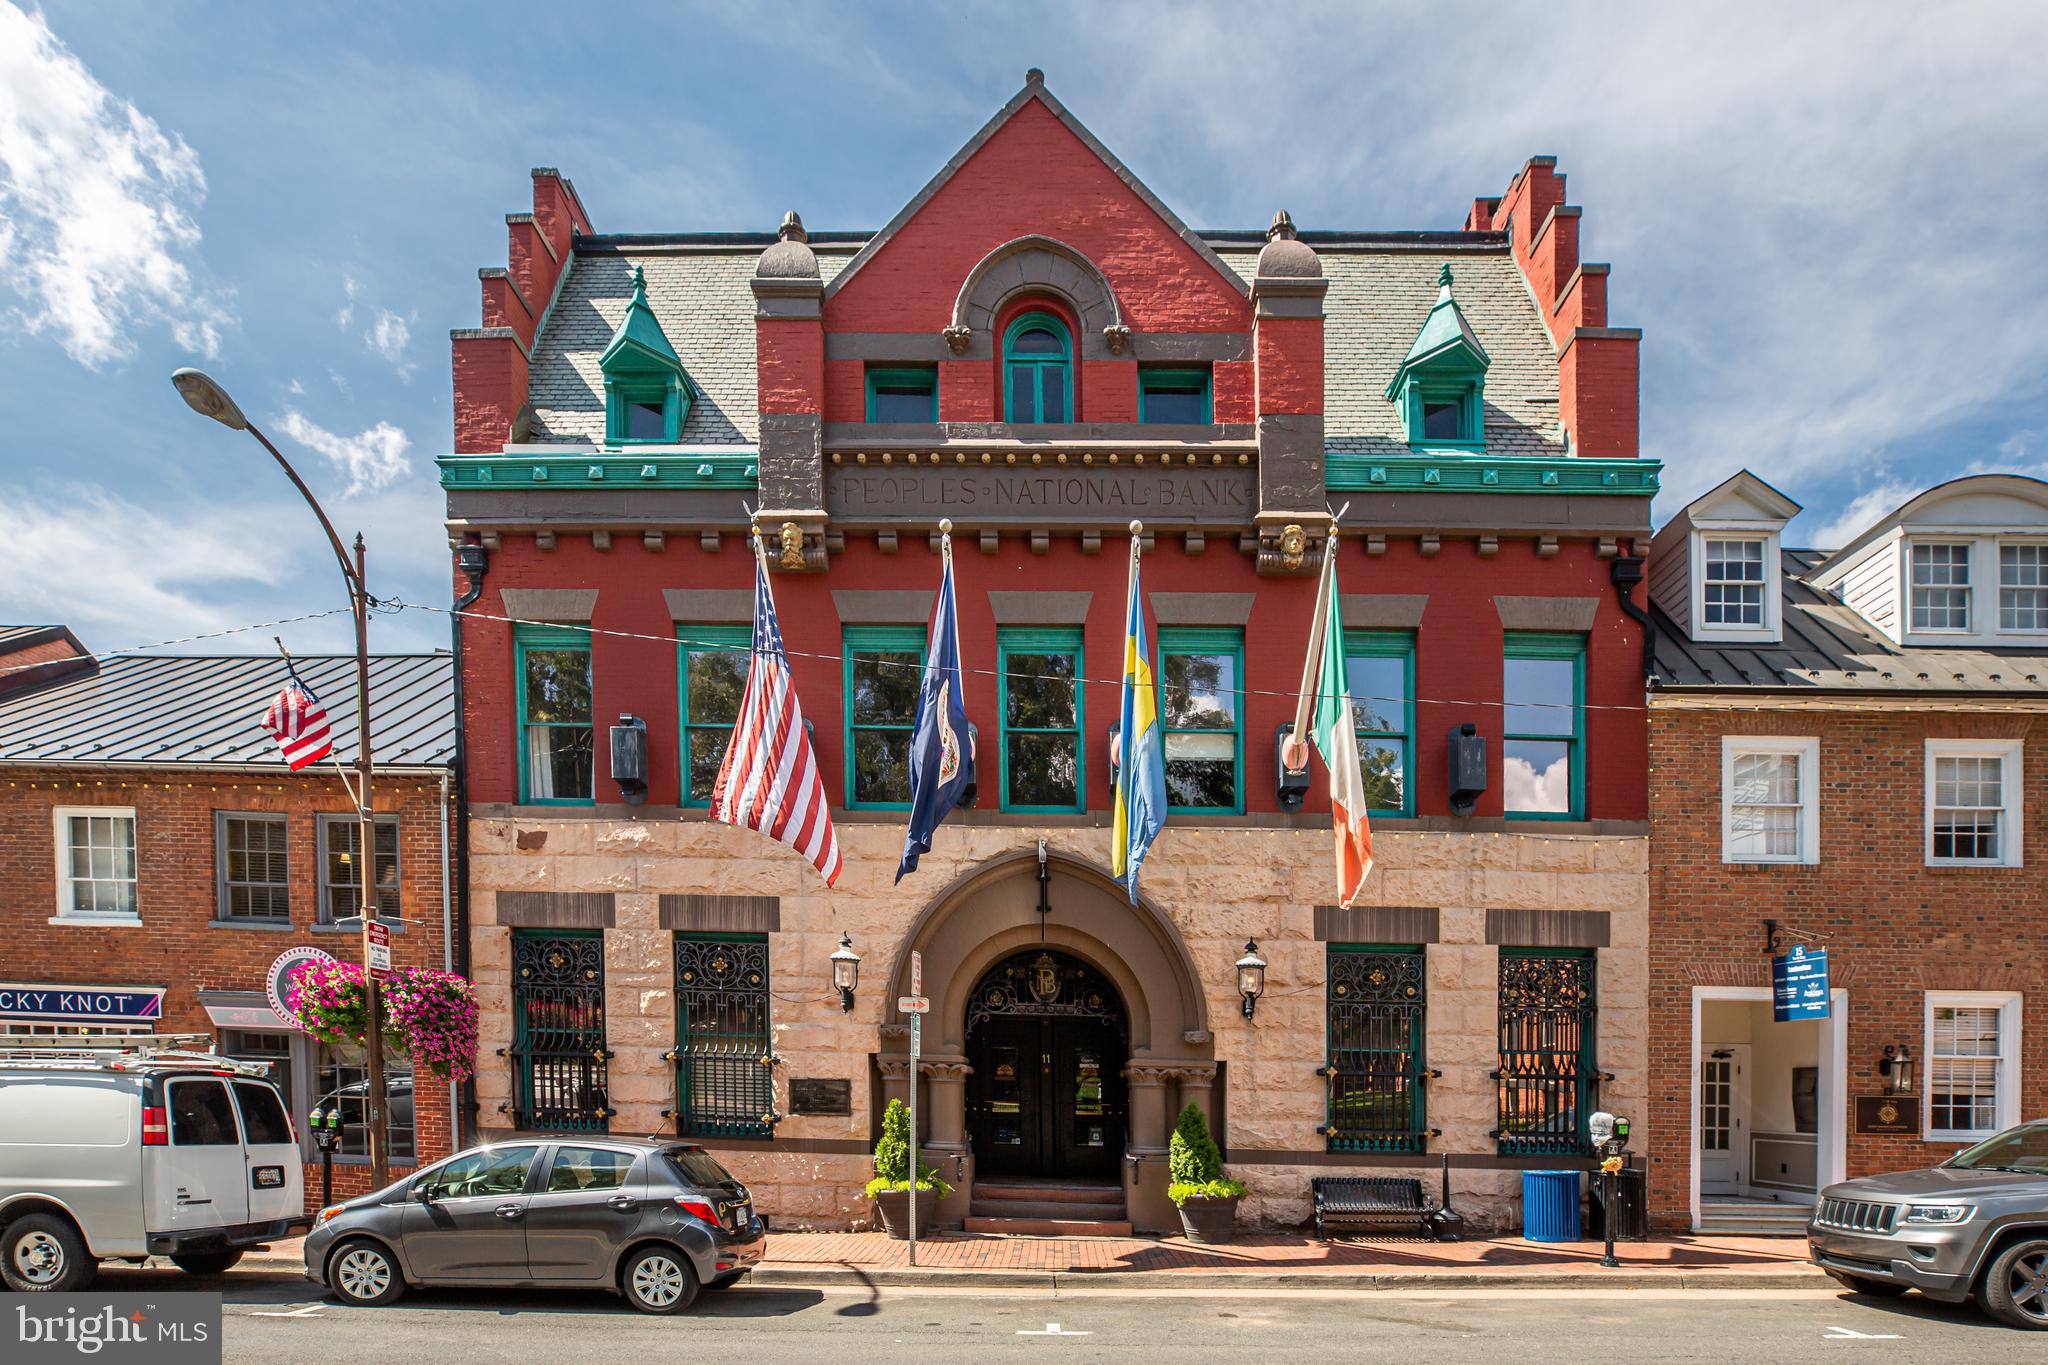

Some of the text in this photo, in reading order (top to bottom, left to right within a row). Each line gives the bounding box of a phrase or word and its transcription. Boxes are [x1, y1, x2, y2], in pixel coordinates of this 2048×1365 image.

[843, 478, 1245, 506] PEOPLES NATIONAL BANK
[1042, 1054, 1051, 1064] 11
